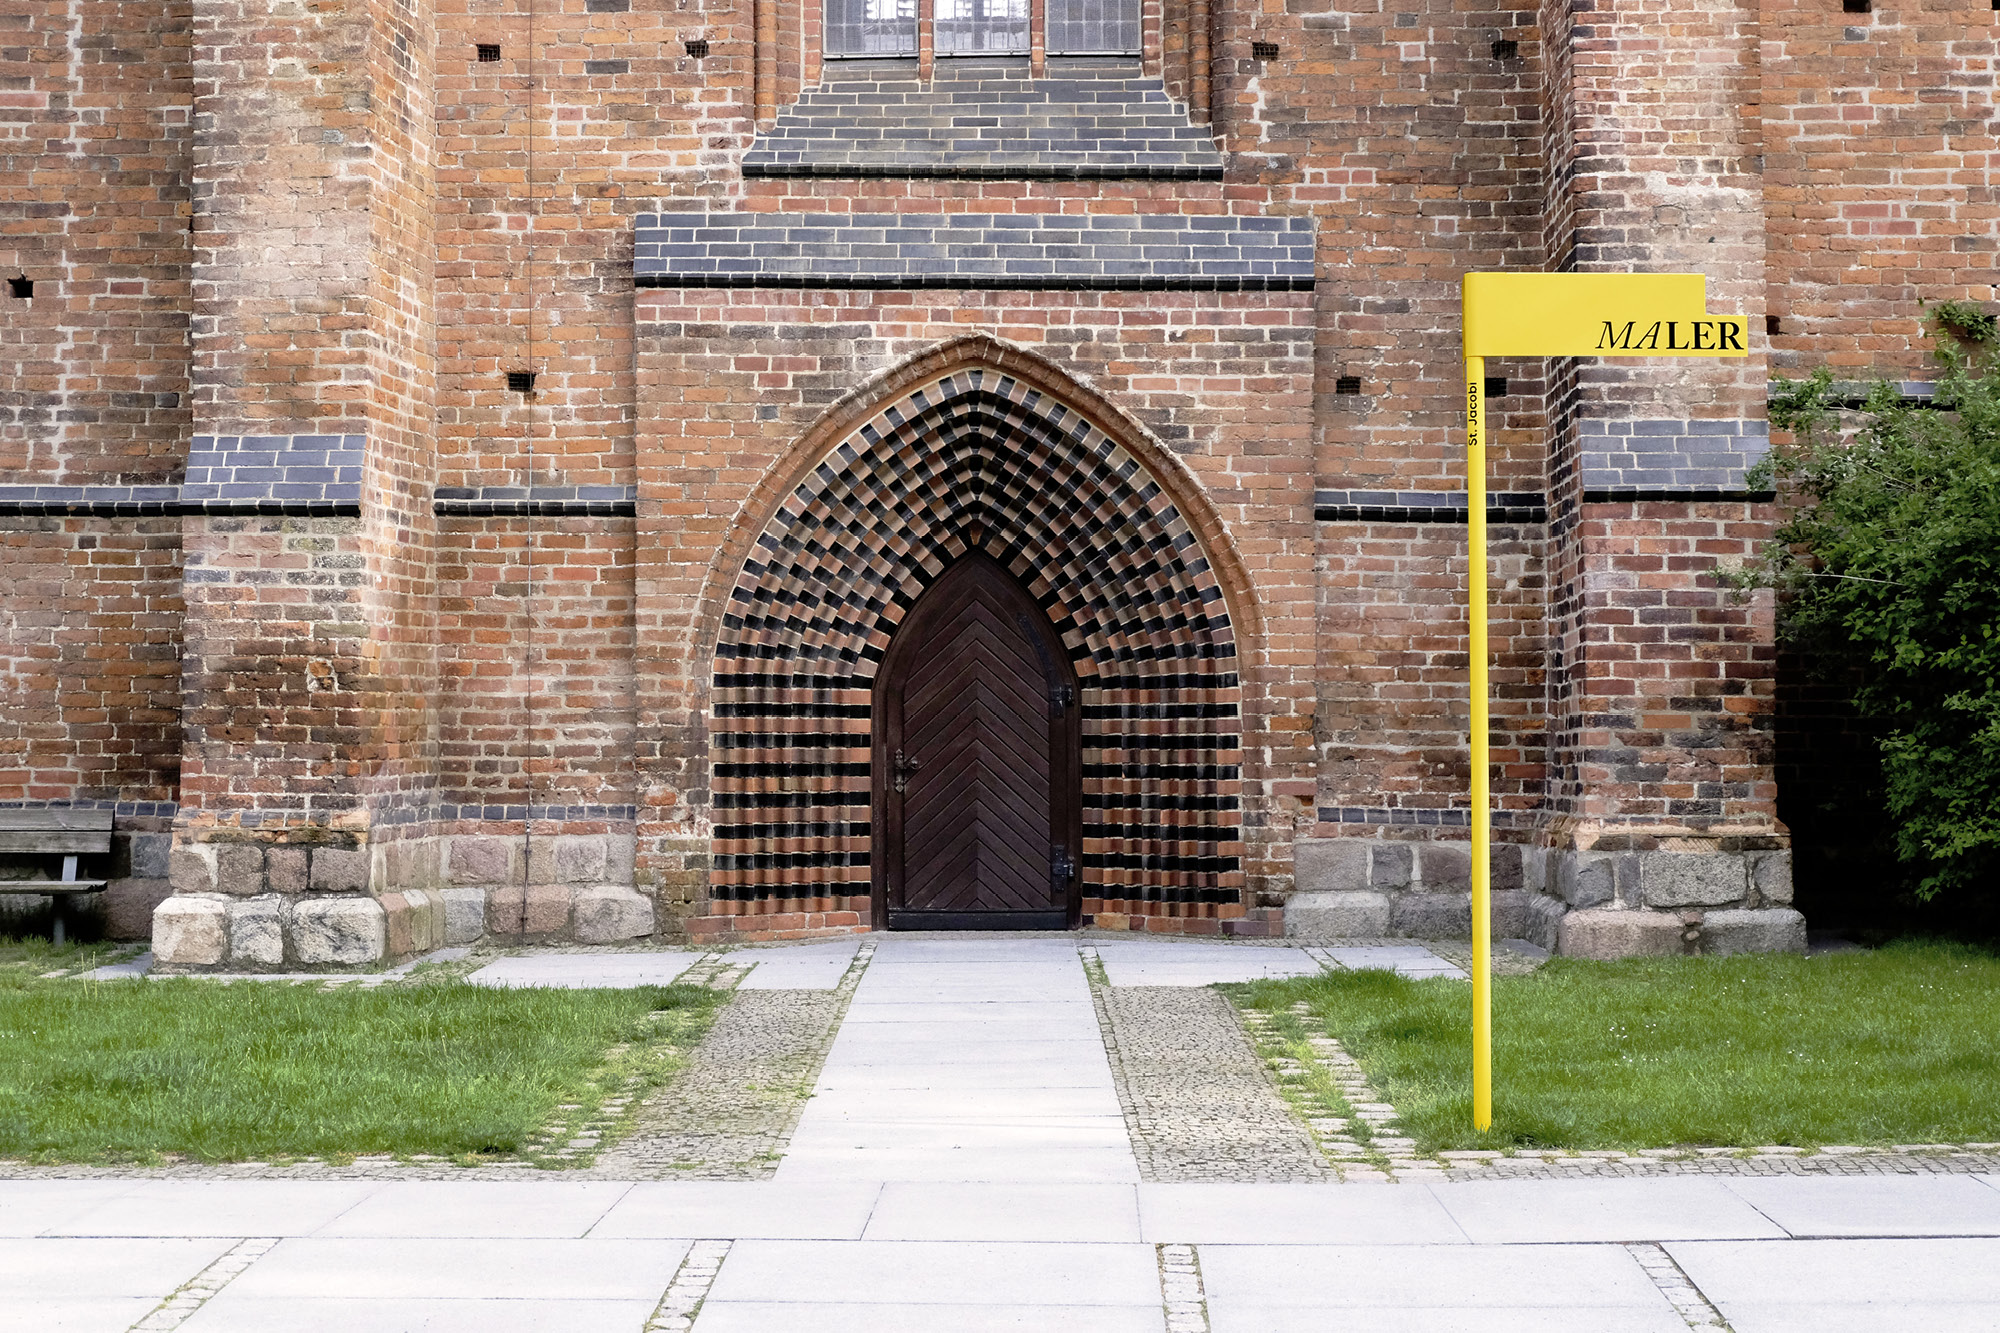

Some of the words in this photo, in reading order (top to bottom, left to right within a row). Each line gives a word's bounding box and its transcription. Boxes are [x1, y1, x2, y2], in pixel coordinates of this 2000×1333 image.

[1595, 321, 1745, 350] MALER
[1468, 382, 1478, 426] Jacobi
[1468, 429, 1478, 446] St.
